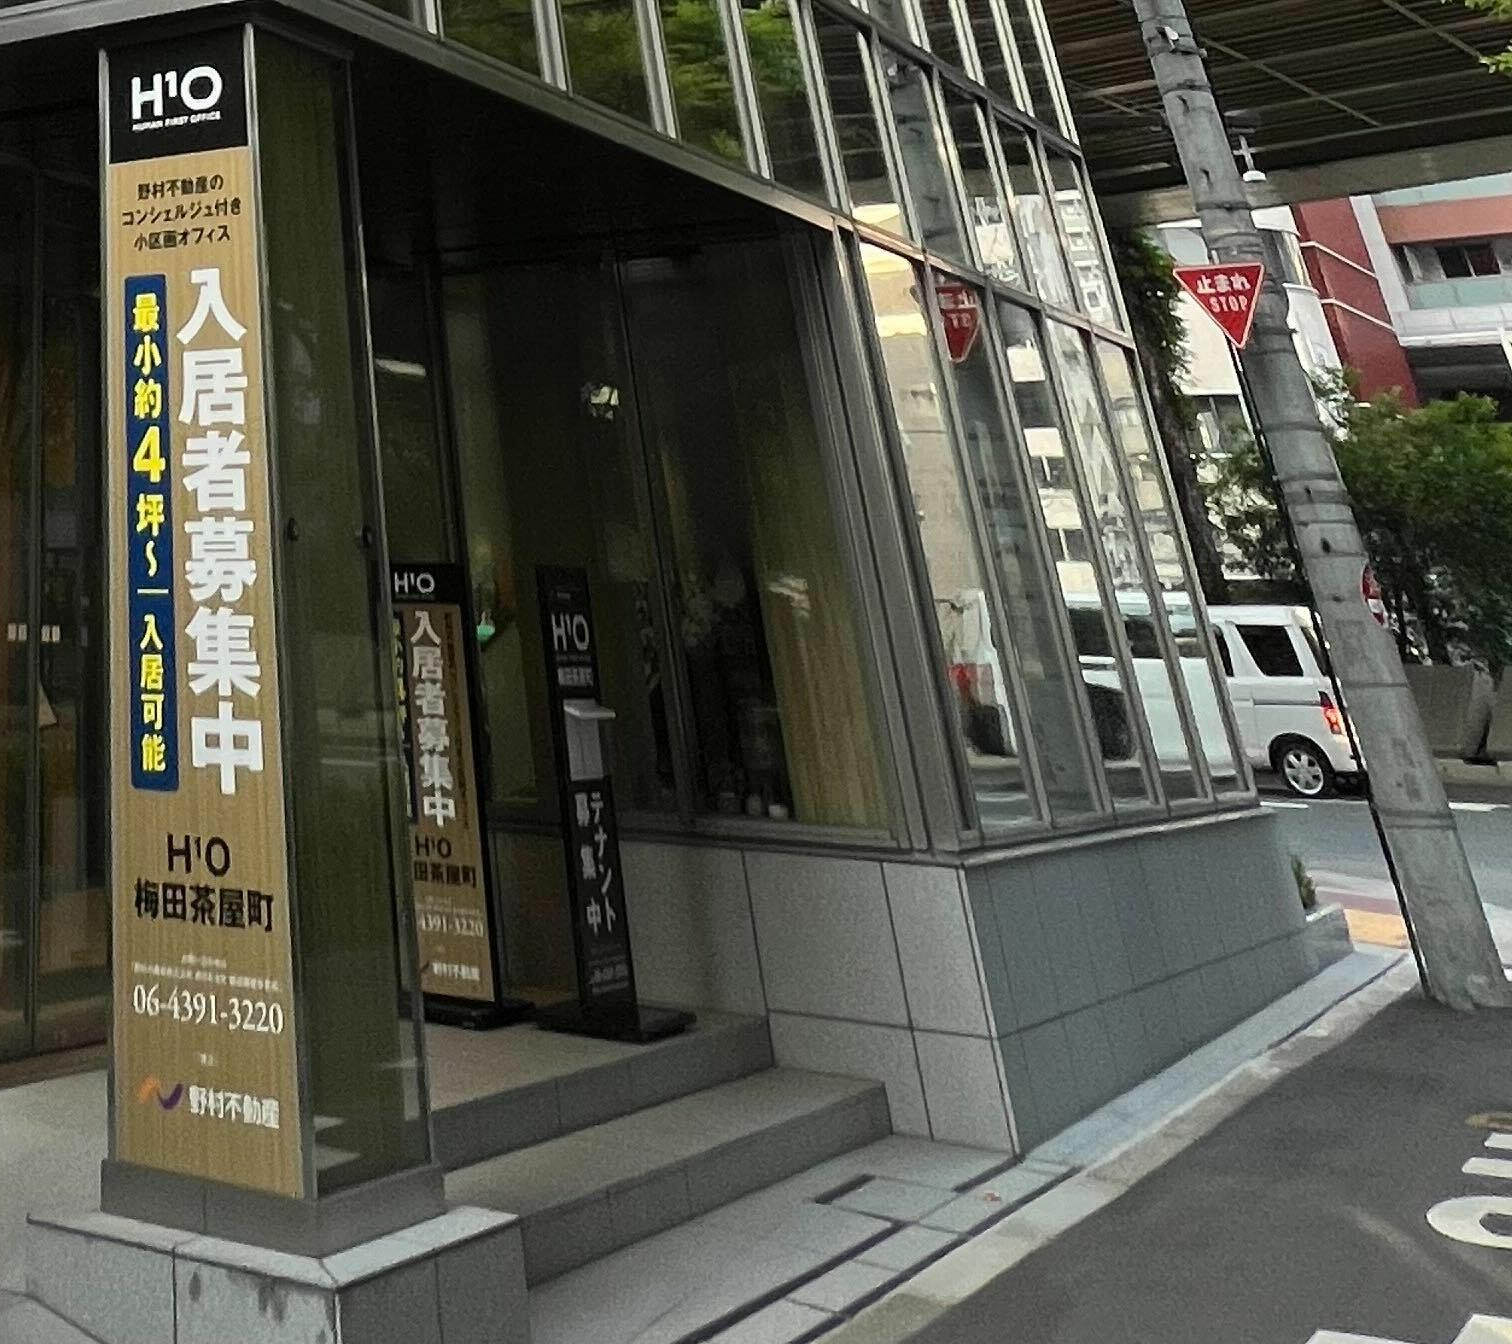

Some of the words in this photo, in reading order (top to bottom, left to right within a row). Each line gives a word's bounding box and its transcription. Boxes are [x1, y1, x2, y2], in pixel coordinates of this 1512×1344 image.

[132, 120, 164, 132] HUMAN
[164, 115, 189, 128] FIRST
[190, 110, 222, 124] OFFICE
[137, 174, 224, 202] 野村不動産の
[121, 197, 242, 227] コンシェルジュ付き
[133, 224, 231, 252] 小区画オフィス
[1195, 272, 1251, 294] 止まれ
[1209, 295, 1248, 313] STOP
[176, 267, 264, 796] 入居者募集中
[410, 610, 456, 829] 入居者募集中
[134, 877, 274, 934] 梅田茶屋町
[133, 983, 285, 1034] 06-4391-3220
[188, 1084, 281, 1130] 野村不動産
